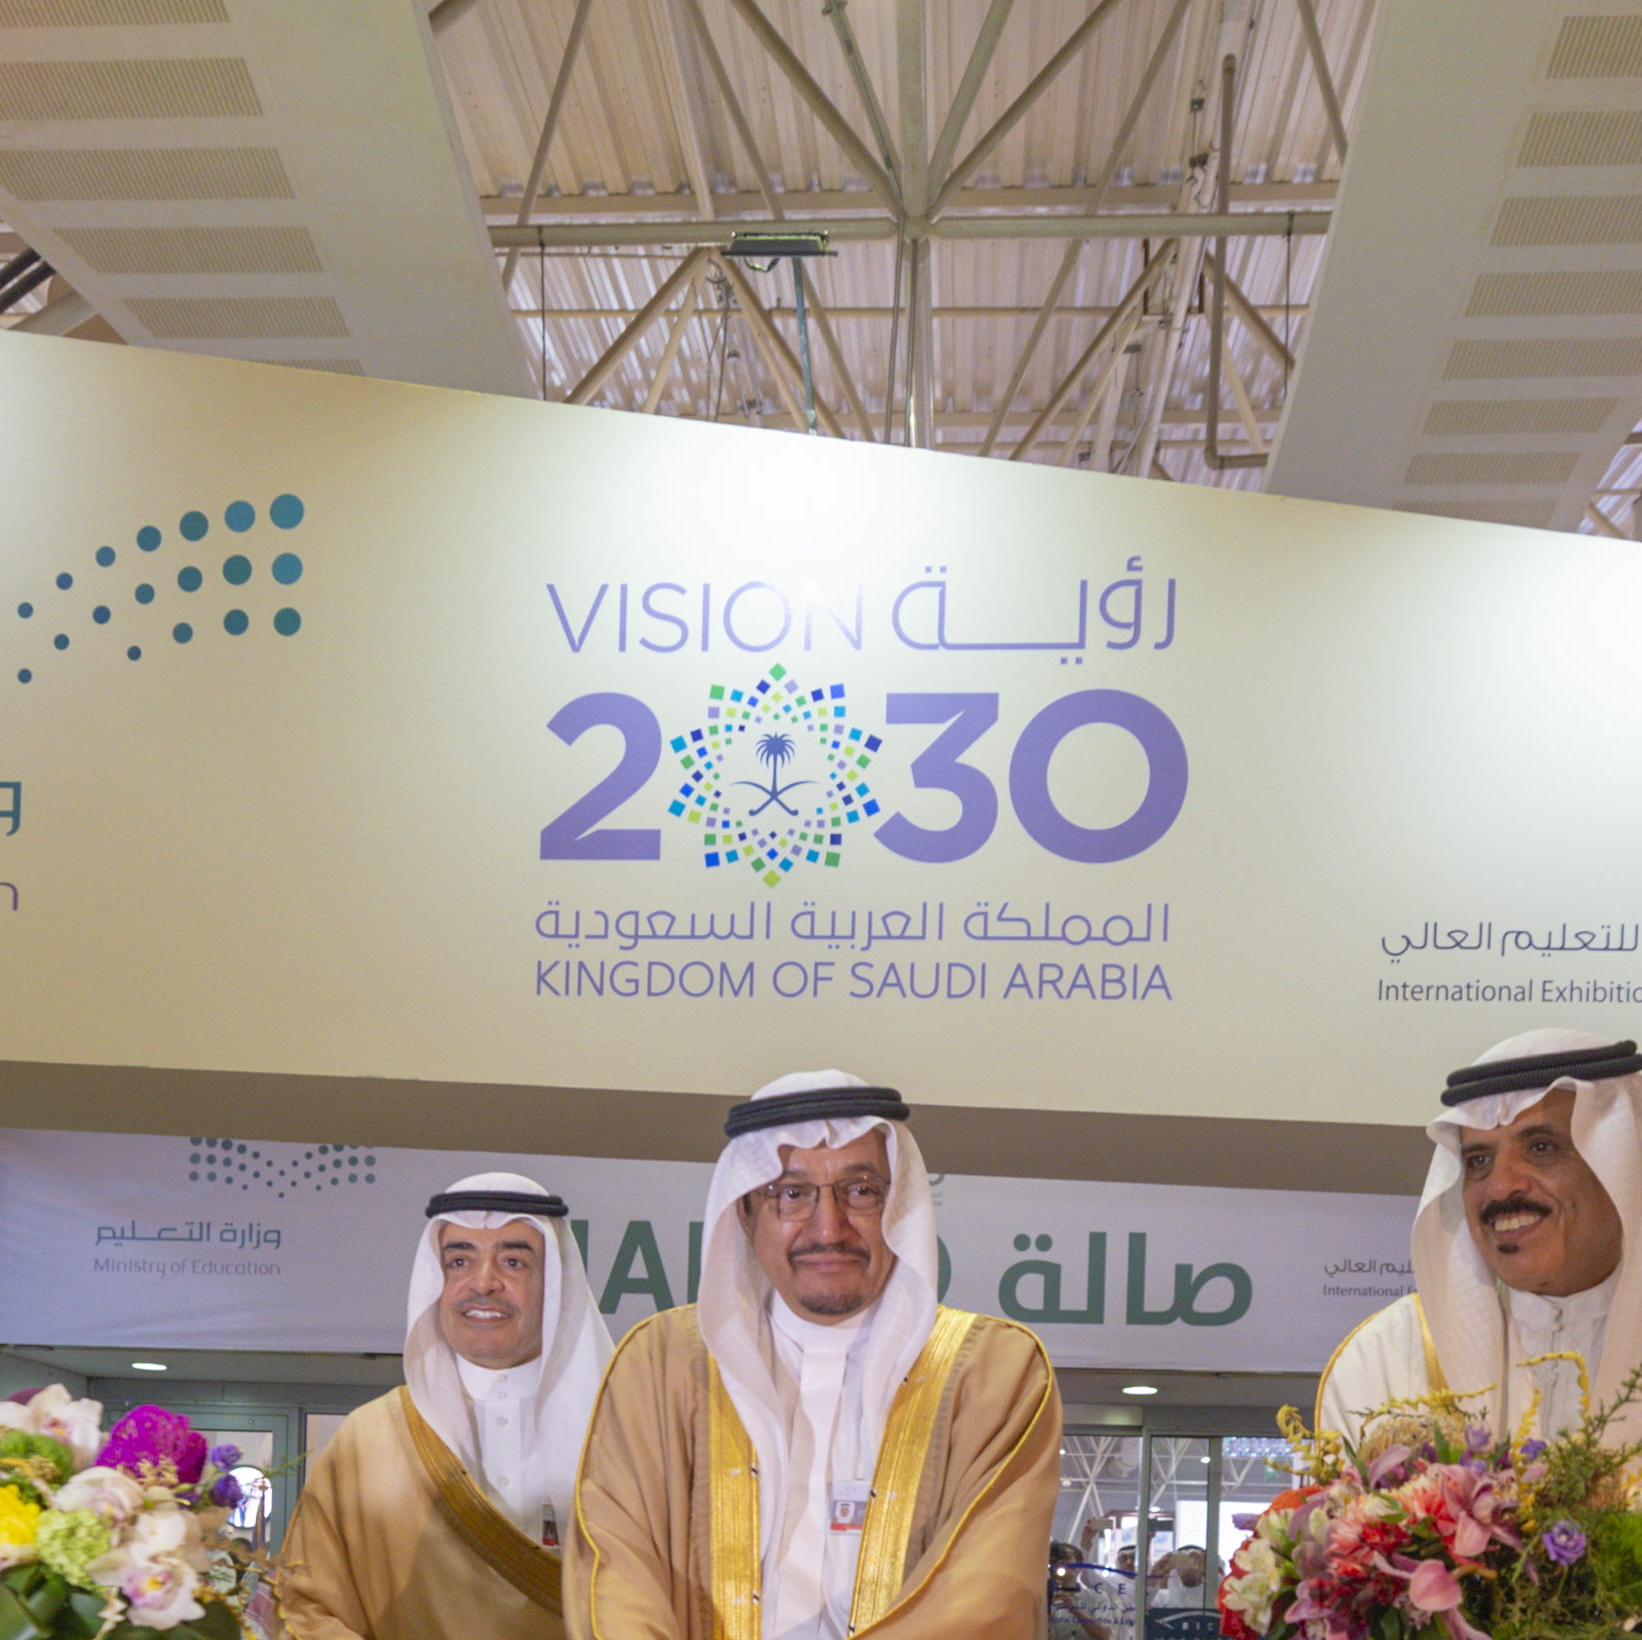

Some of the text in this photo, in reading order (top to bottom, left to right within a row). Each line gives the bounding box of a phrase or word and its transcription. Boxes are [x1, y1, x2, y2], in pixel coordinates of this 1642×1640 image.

[545, 579, 864, 654] VISION
[891, 555, 1177, 665] رؤية
[534, 900, 1171, 952] المملكة العربية السعودية
[1381, 922, 1492, 964] العالي
[1500, 924, 1640, 958] للتعليم
[535, 960, 1174, 1001] KINGDOM OF SAUDI ARABIA
[1377, 979, 1534, 1003] International
[95, 1220, 282, 1250] وزارة التعليم
[93, 1256, 281, 1279] Ministry of Education
[997, 1231, 1254, 1327] صالة
[1323, 1284, 1404, 1297] International
